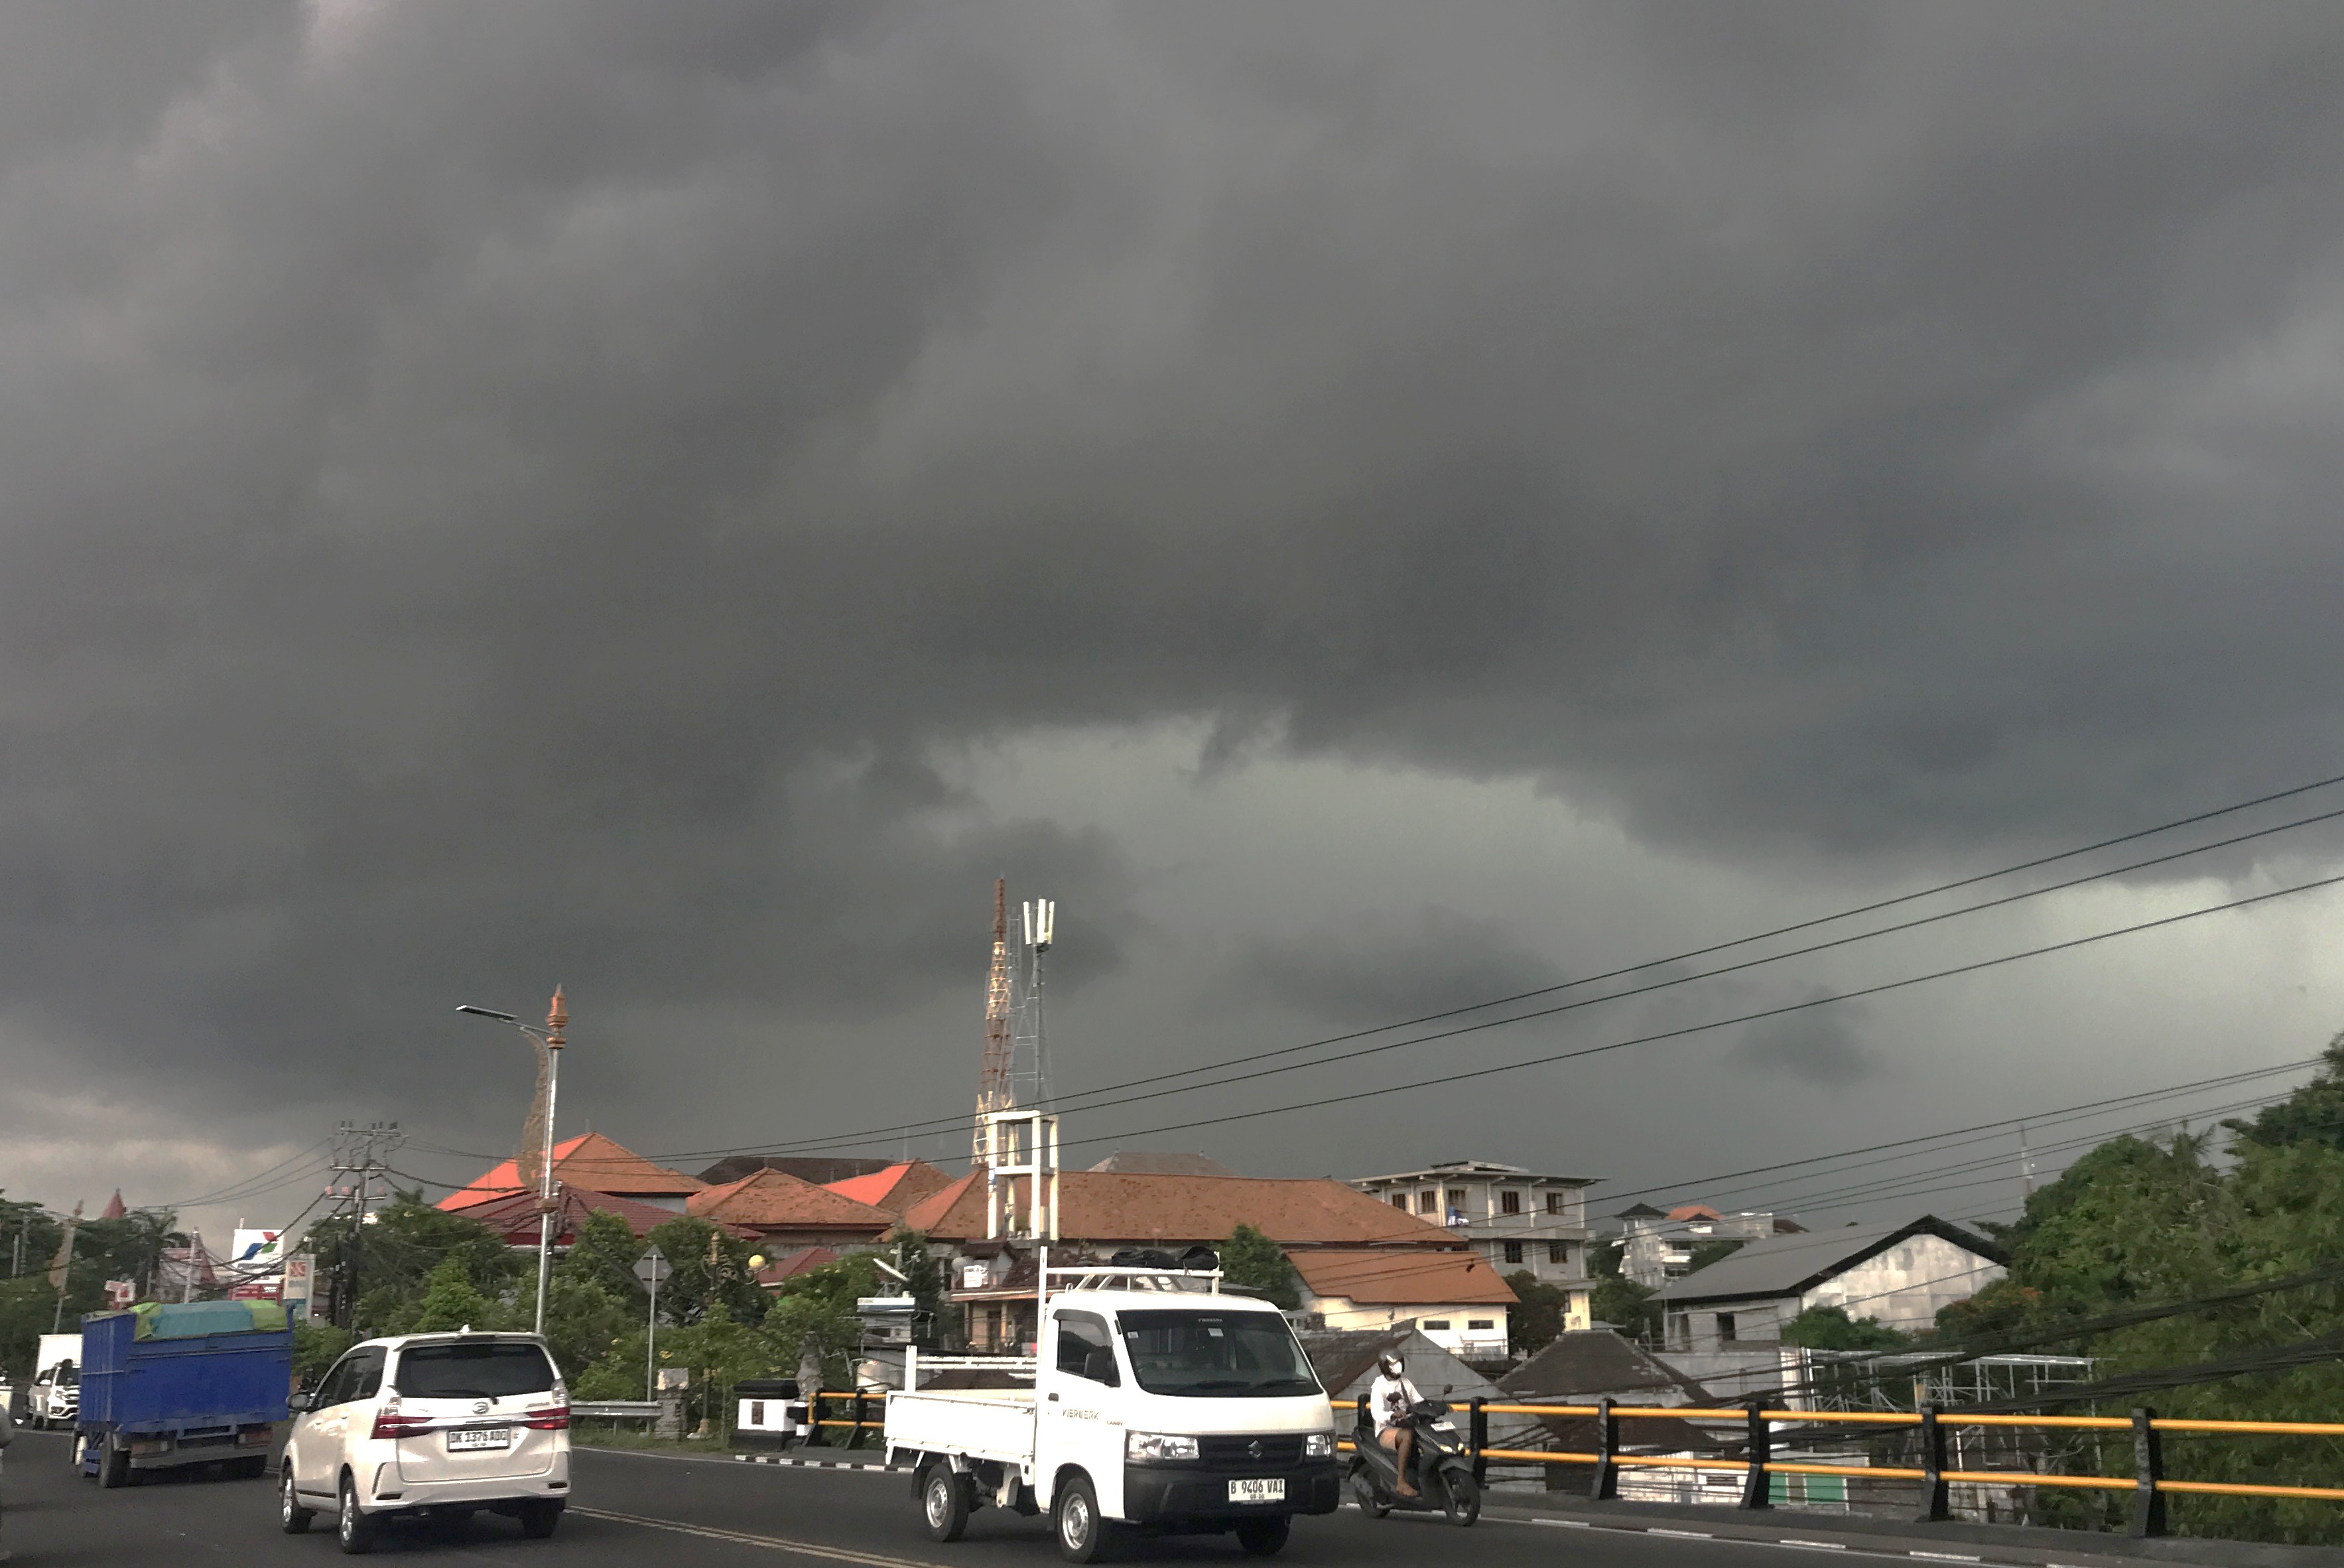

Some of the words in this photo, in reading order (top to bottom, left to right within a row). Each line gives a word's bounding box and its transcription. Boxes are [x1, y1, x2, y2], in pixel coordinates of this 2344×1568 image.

[1231, 1481, 1236, 1494] B
[1242, 1480, 1264, 1494] 9406
[1267, 1480, 1283, 1494] VAI
